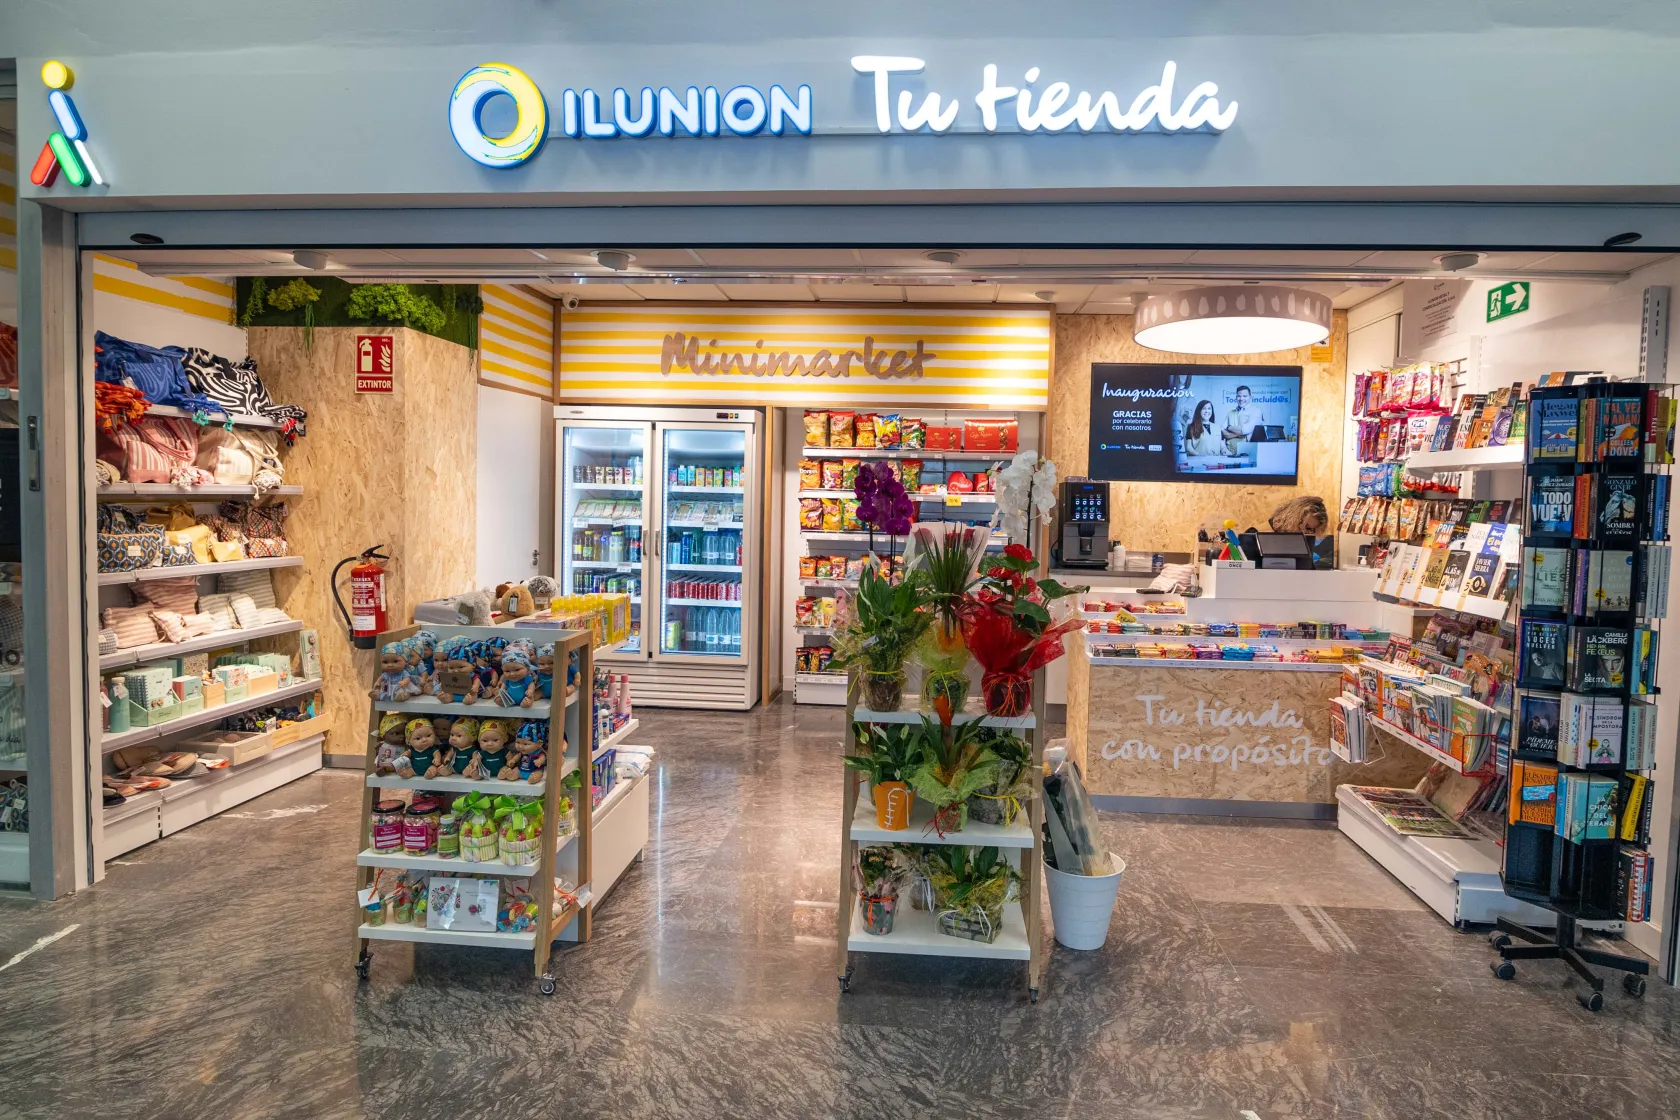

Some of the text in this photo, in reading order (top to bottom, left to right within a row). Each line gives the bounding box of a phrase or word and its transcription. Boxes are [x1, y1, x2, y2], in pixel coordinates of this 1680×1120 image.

[850, 55, 1239, 135] Tu tienda
[562, 84, 813, 138] ILUNION
[659, 331, 937, 379] Minimarket
[358, 380, 391, 388] EXTINTOR
[1102, 382, 1195, 402] Inauguración
[1112, 410, 1152, 418] GRACIAS
[1605, 402, 1621, 413] TAL
[1542, 492, 1571, 504] TODO
[1531, 504, 1573, 522] VUELV
[1537, 573, 1566, 582] LIES
[1526, 642, 1556, 650] VUELVEN
[1135, 695, 1304, 728] Tu tienda
[1101, 736, 1336, 771] con propósito
